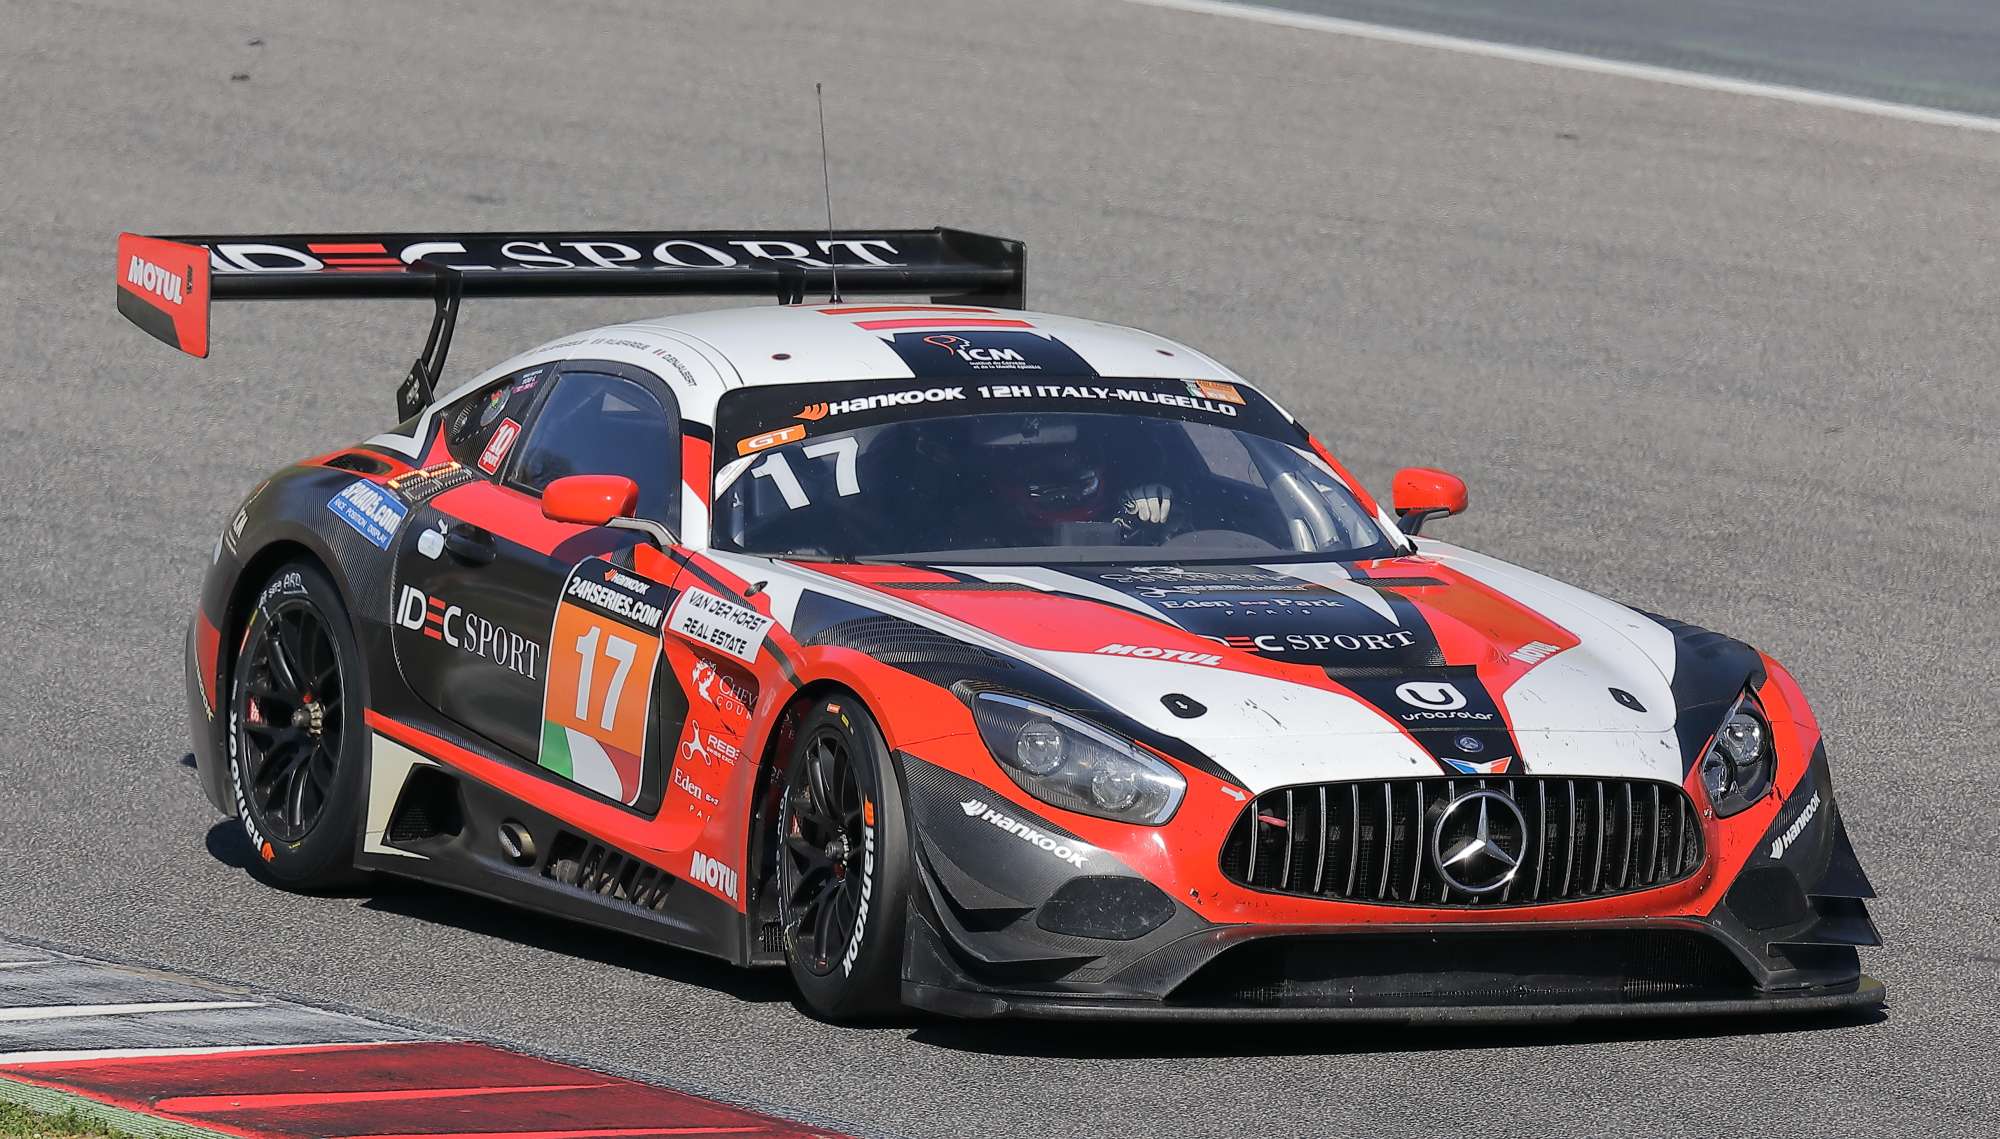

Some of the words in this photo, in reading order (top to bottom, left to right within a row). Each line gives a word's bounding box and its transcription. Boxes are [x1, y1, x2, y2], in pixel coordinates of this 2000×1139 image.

[501, 239, 907, 269] SPORT
[127, 254, 183, 305] MOTUL
[977, 384, 1032, 399] 12H
[1035, 385, 1238, 417] ITALY-MUGELLO
[748, 428, 796, 449] GT
[750, 436, 861, 510] 17
[333, 498, 348, 511] RACE
[345, 507, 368, 528] POSITION
[366, 523, 389, 544] DISPLAY
[567, 576, 664, 629] 24HSERIES.COM
[688, 589, 709, 611] VAN
[708, 599, 733, 620] DER
[731, 608, 768, 634] HORST
[1158, 599, 1234, 609] Eden
[1271, 598, 1345, 608] Park
[396, 583, 462, 648] IDEC
[464, 613, 541, 681] SPORT
[682, 617, 709, 641] REAL
[710, 628, 748, 655] ESTATE
[1285, 630, 1416, 651] SPORT
[1094, 642, 1224, 667] MOTUL
[575, 625, 638, 732] 17
[1401, 711, 1494, 721] urbasolar
[674, 766, 702, 800] Eden
[690, 850, 738, 902] MOTUL
